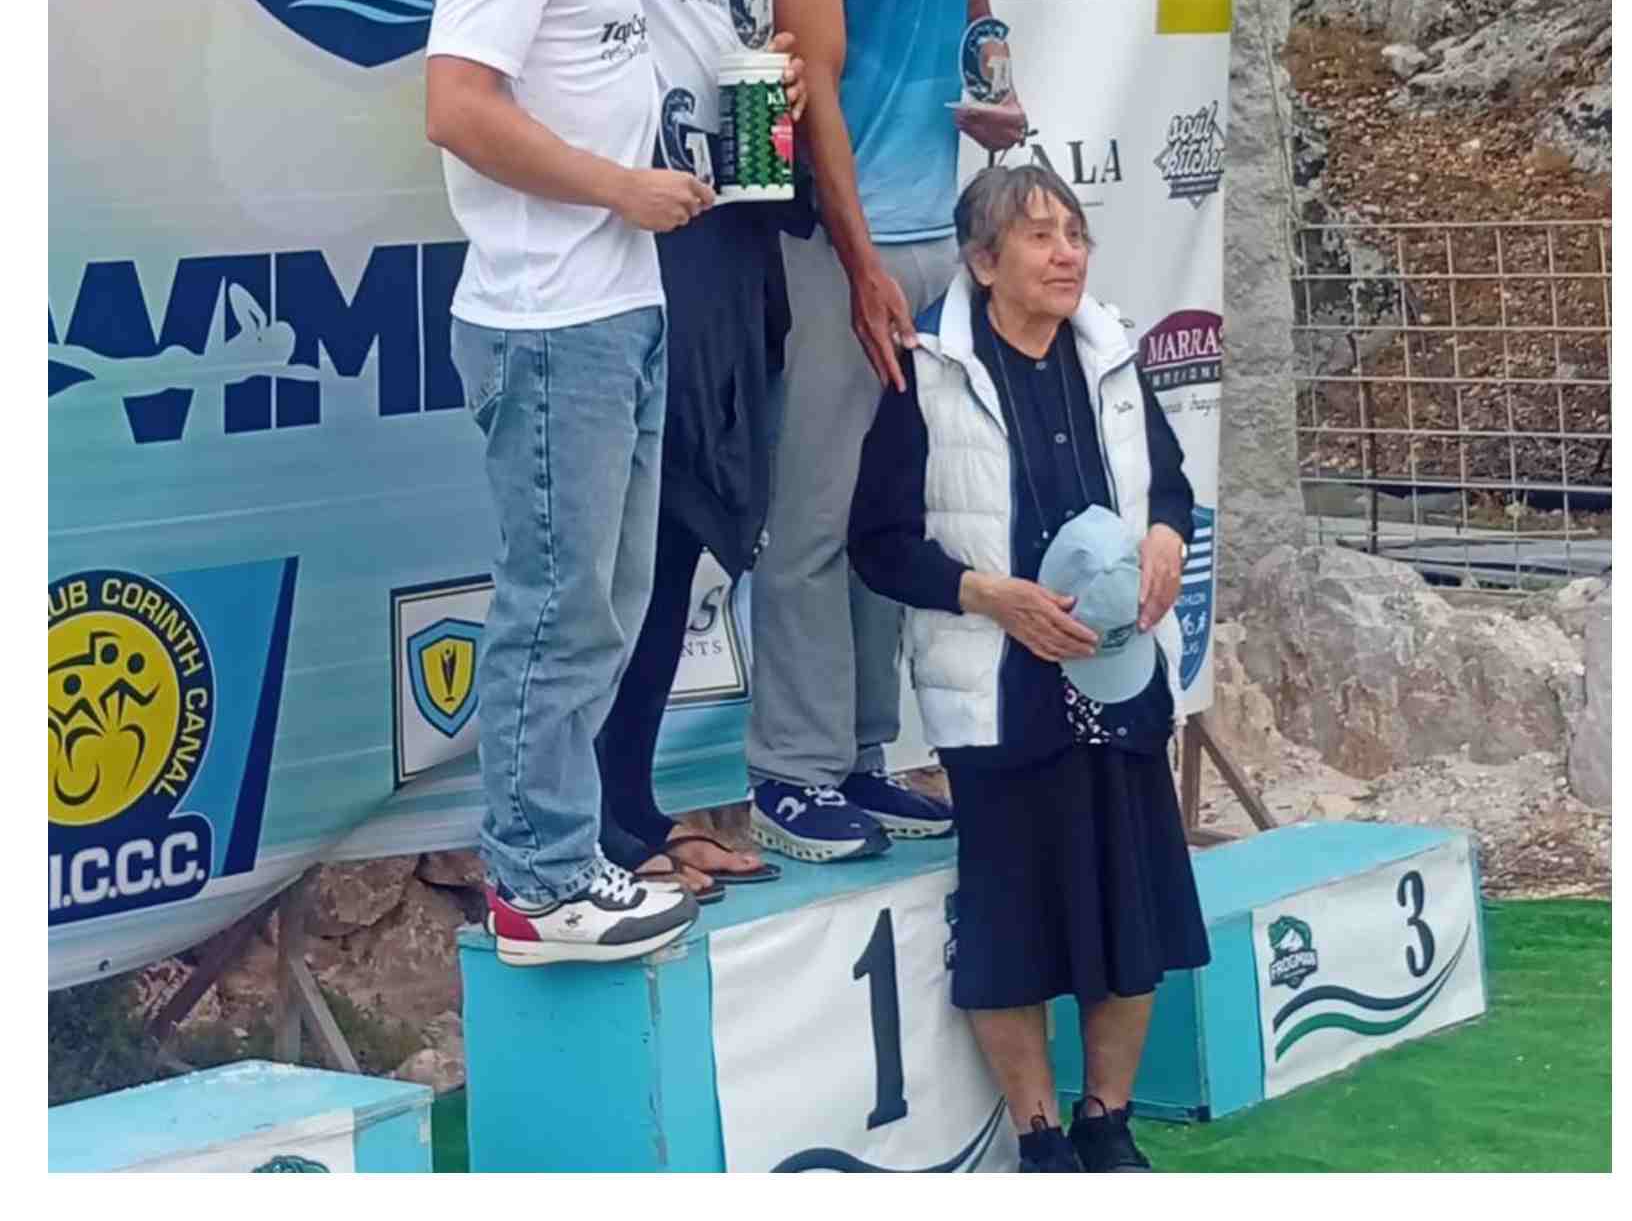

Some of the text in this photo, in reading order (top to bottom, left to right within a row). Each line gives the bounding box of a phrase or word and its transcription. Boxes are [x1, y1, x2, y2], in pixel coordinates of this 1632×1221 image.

[101, 578, 205, 678] CORINTH
[153, 687, 208, 798] CANAL
[853, 907, 908, 1131] 1
[1397, 870, 1435, 978] 3
